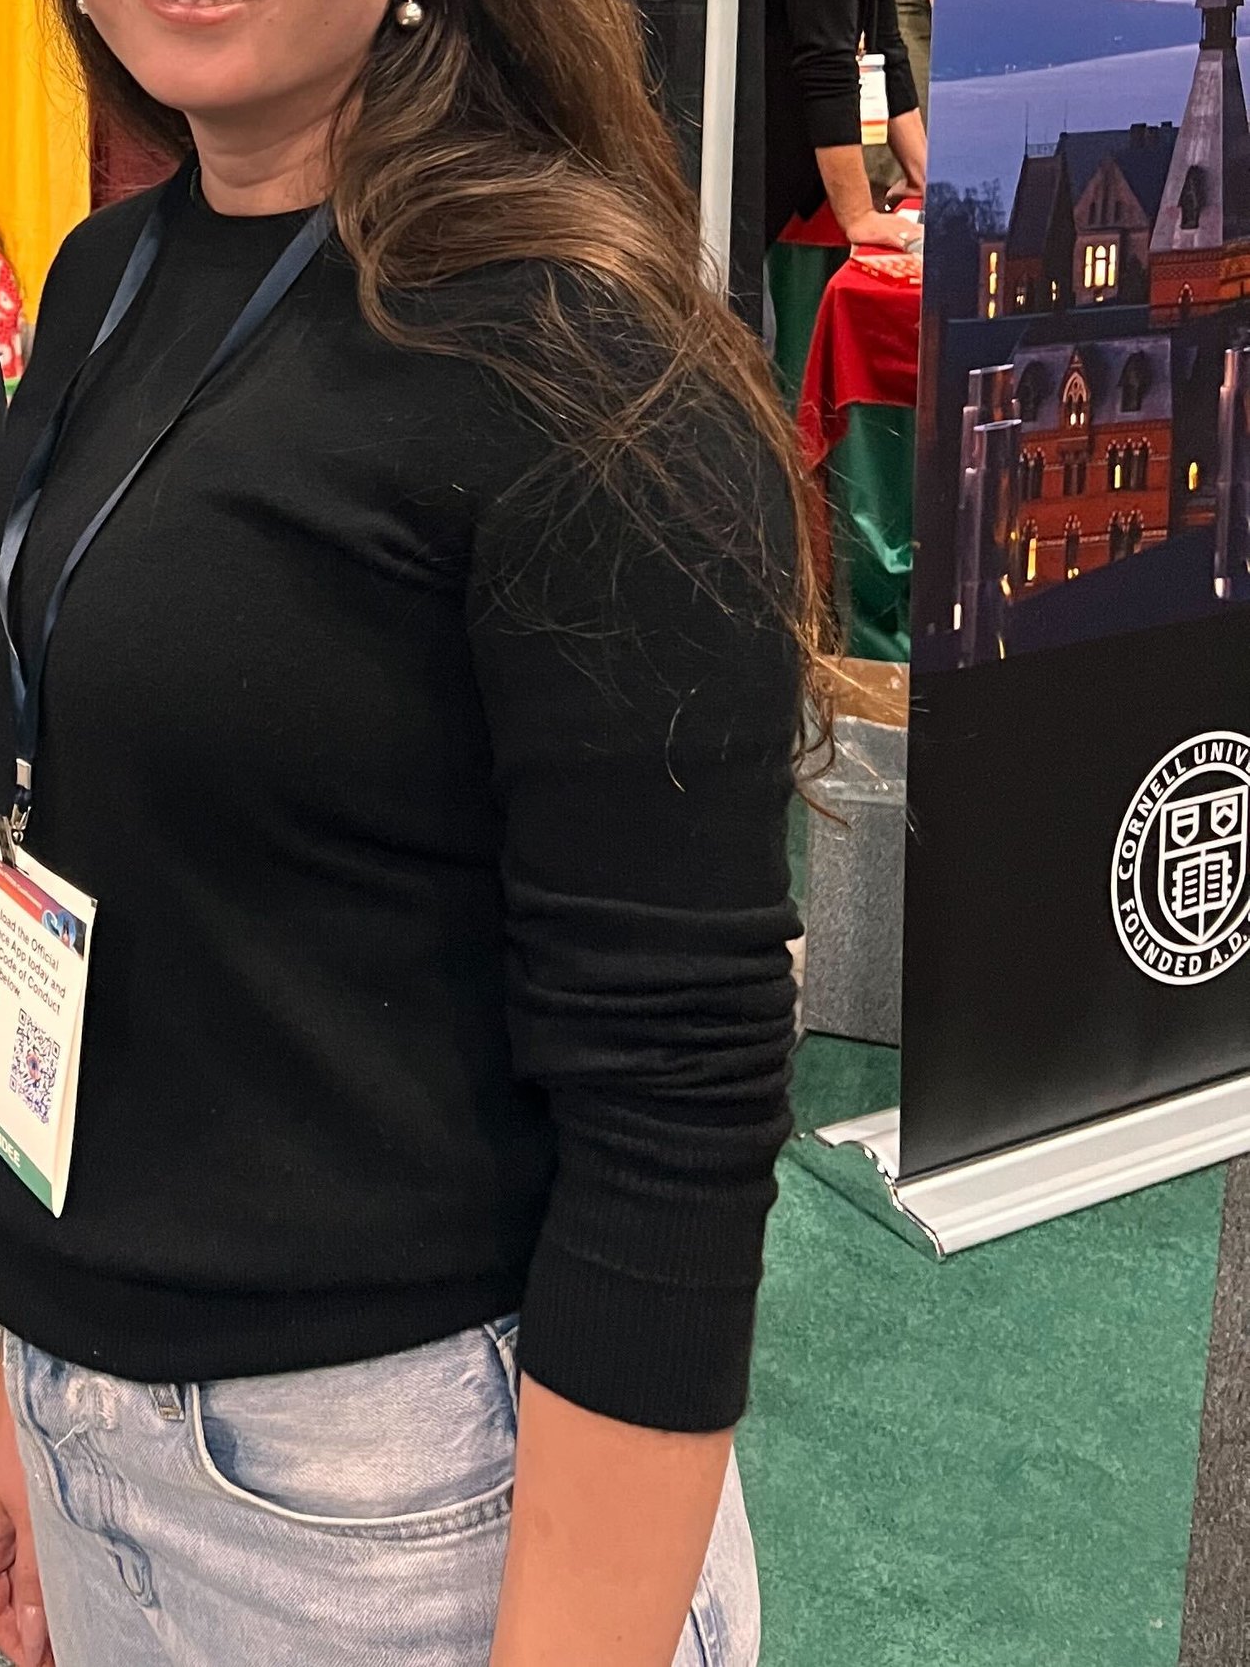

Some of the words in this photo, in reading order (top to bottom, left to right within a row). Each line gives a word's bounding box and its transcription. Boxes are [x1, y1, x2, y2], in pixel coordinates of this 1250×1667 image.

[1119, 757, 1187, 881] CORNELL
[1194, 741, 1250, 774] UNIV
[17, 925, 30, 945] the
[31, 938, 60, 972] Official
[1120, 898, 1202, 976] FOUNDED
[11, 940, 26, 962] App
[27, 955, 49, 985] today
[50, 978, 66, 999] and
[18, 969, 27, 982] of
[27, 975, 61, 1016] Conduct
